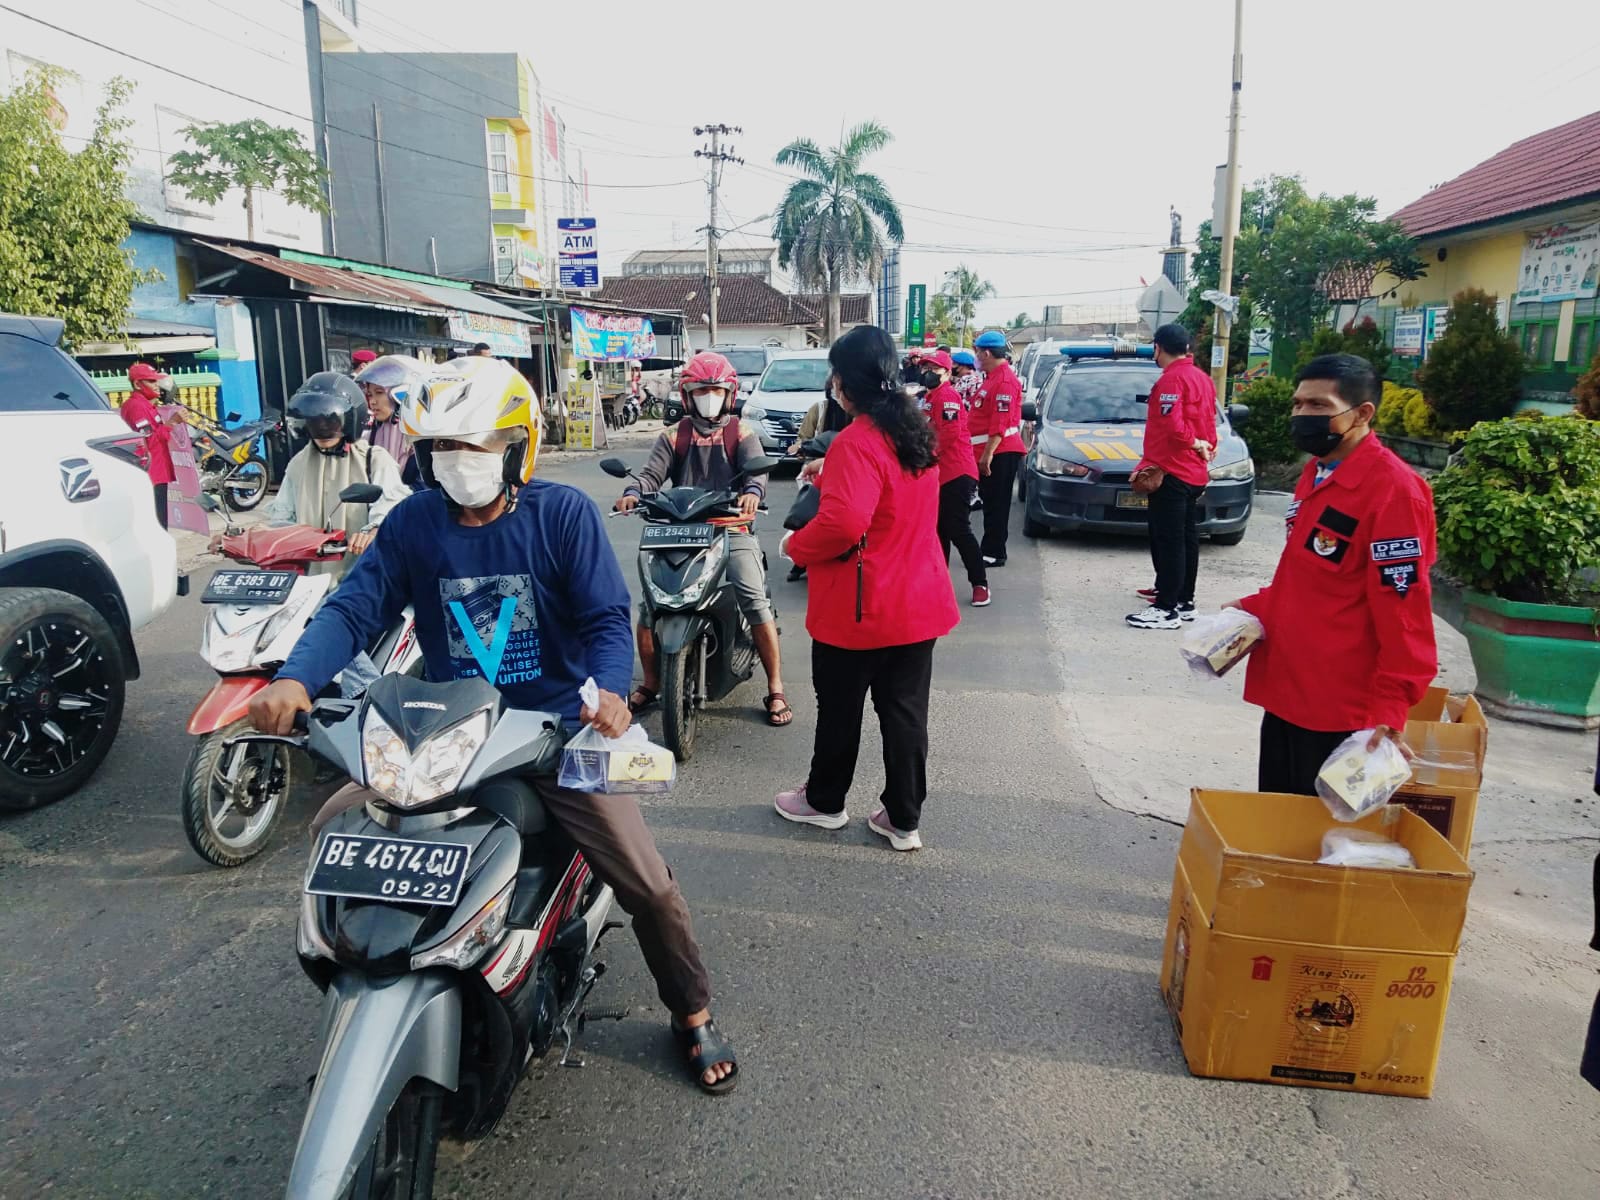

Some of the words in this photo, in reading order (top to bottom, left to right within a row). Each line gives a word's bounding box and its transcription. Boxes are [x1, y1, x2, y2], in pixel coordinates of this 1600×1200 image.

[564, 236, 593, 248] ATM
[647, 528, 661, 537] BE
[664, 527, 690, 537] 2949
[695, 527, 709, 536] UV
[1377, 541, 1415, 552] DPC
[215, 575, 232, 587] BE
[235, 575, 265, 587] 6385
[269, 576, 288, 587] UY
[403, 701, 447, 711] HONDA
[324, 840, 362, 867] BE
[364, 843, 426, 873] 4674
[1299, 965, 1333, 980] King
[1340, 969, 1367, 980] Size
[1407, 966, 1427, 981] 12
[1385, 984, 1436, 999] 9600
